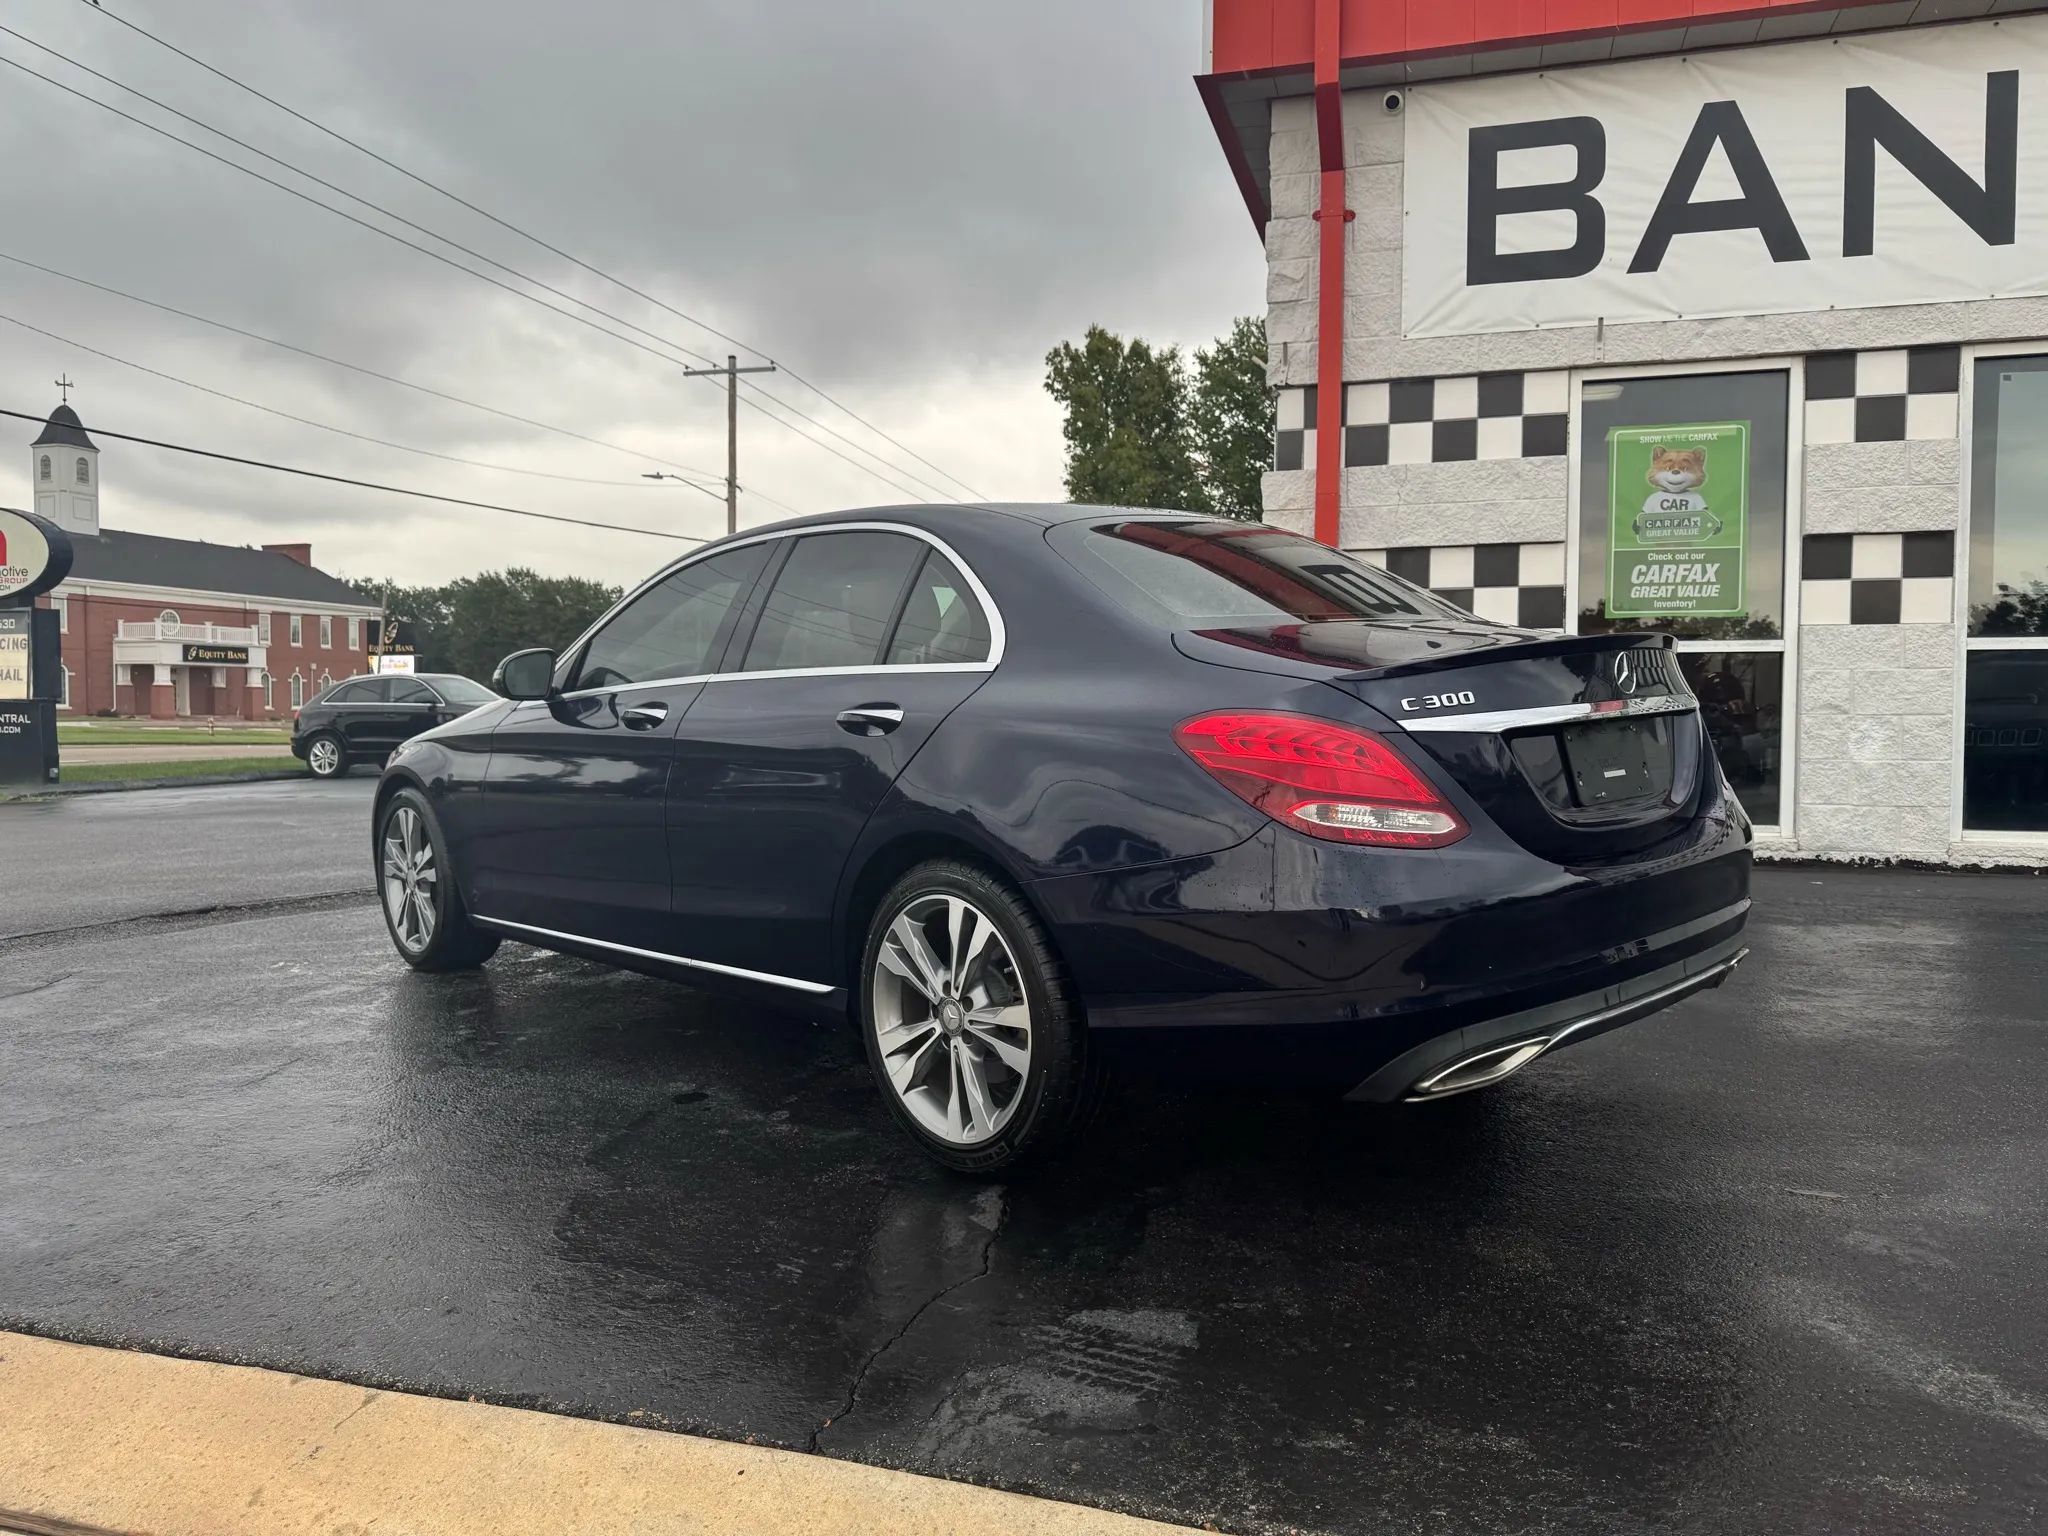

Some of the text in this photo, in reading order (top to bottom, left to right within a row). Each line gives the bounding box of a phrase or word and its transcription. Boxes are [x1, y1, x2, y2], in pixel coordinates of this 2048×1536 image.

[1466, 70, 2019, 286] BAN
[1640, 435, 1662, 444] SHOW
[1688, 432, 1719, 441] CARFAX
[1660, 499, 1690, 511] CAR
[1646, 518, 1700, 527] CARFAX
[1646, 528, 1700, 537] GREAT VALUE
[1648, 552, 1673, 560] Check
[1675, 552, 1688, 560] out
[0, 566, 28, 577] otive
[1631, 563, 1720, 584] CARFAX
[1631, 584, 1720, 598] GREAT VALUE
[1654, 600, 1696, 608] Inventory!
[369, 644, 393, 653] EQITY
[227, 650, 247, 660] BANK
[1400, 690, 1476, 712] C 300
